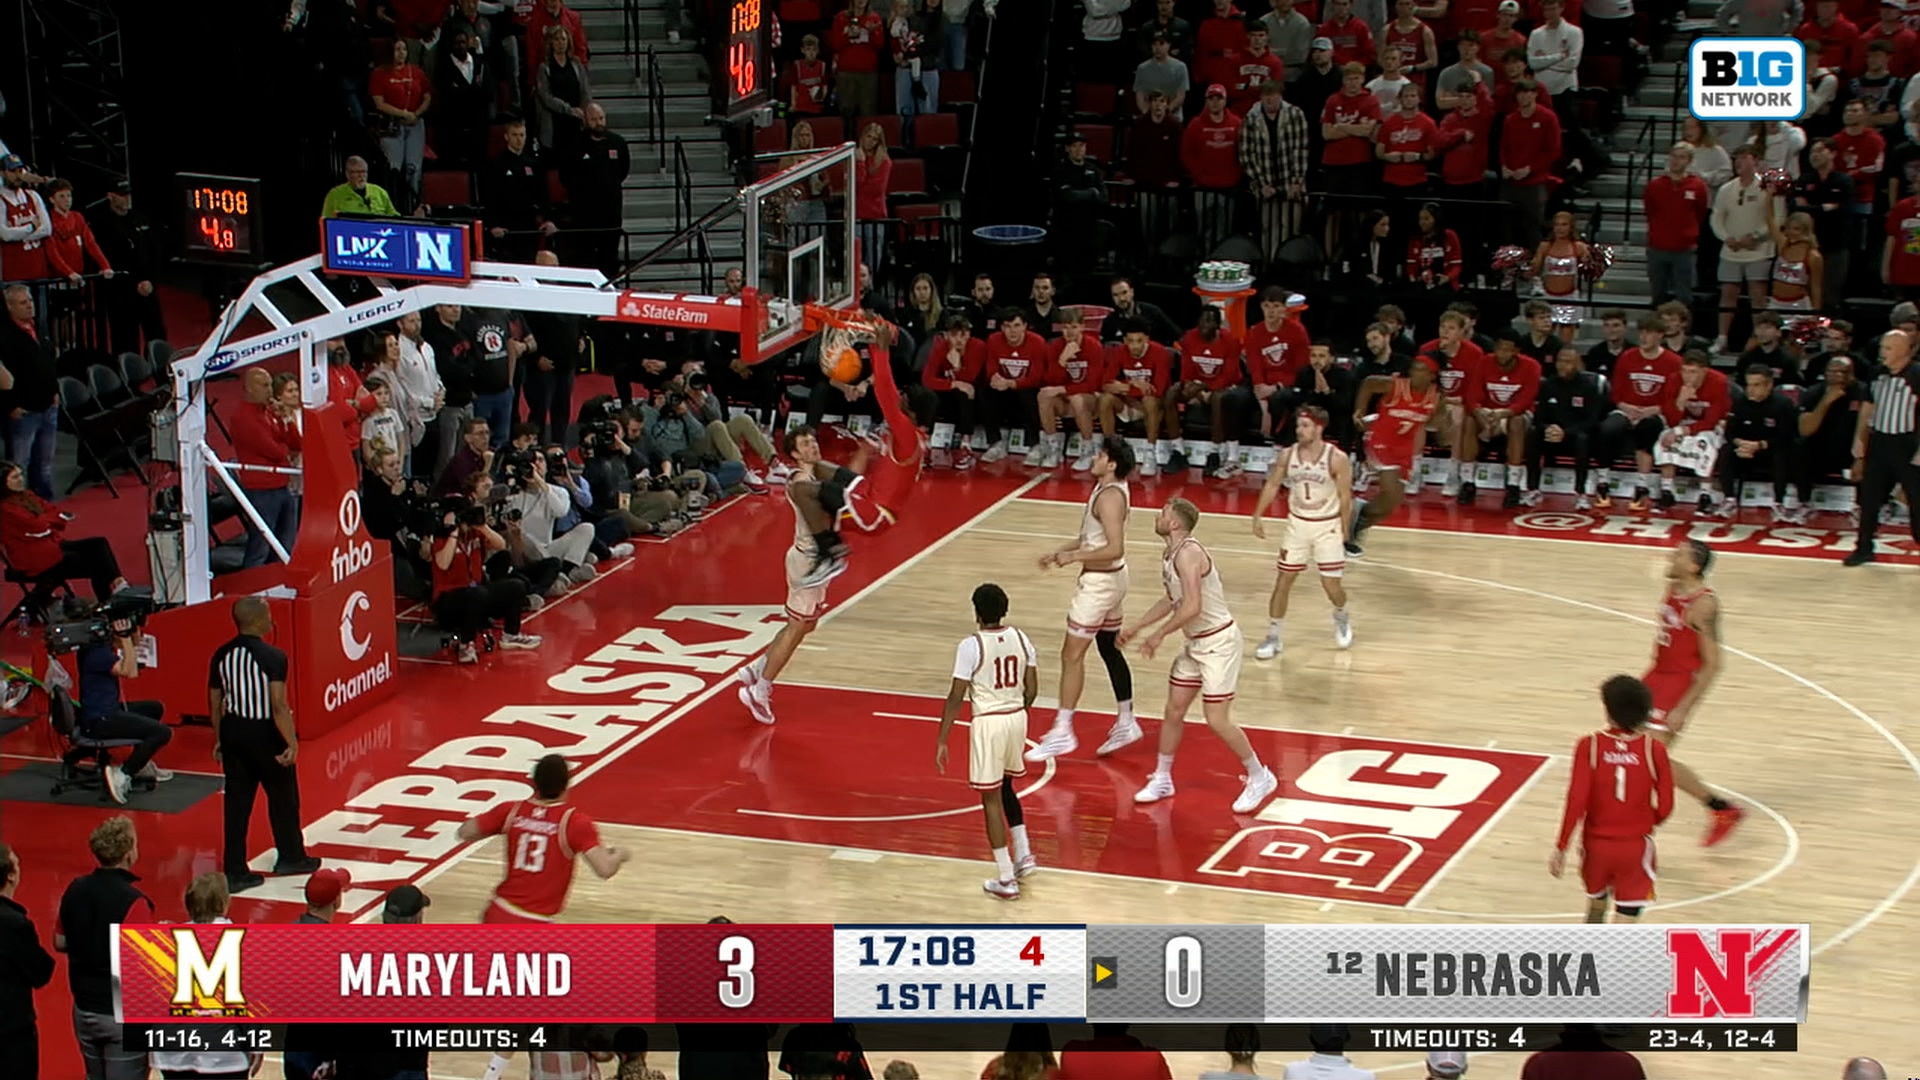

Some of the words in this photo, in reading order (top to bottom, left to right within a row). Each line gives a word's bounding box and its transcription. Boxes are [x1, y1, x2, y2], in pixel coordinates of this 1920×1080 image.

[731, 0, 760, 34] 17:08
[194, 187, 248, 214] 17:08
[201, 216, 233, 249] 4.8
[336, 235, 389, 259] LNK
[415, 231, 455, 272] N
[348, 299, 405, 324] LEGACY
[240, 332, 300, 358] SPORTS
[1397, 421, 1415, 435] 7
[1304, 482, 1311, 500] 1
[1513, 511, 1920, 557] @HUSK
[331, 540, 373, 584] fnbo
[324, 652, 390, 712] Channel
[993, 655, 1018, 690] 10
[1615, 765, 1626, 802] 1
[513, 832, 549, 873] 13
